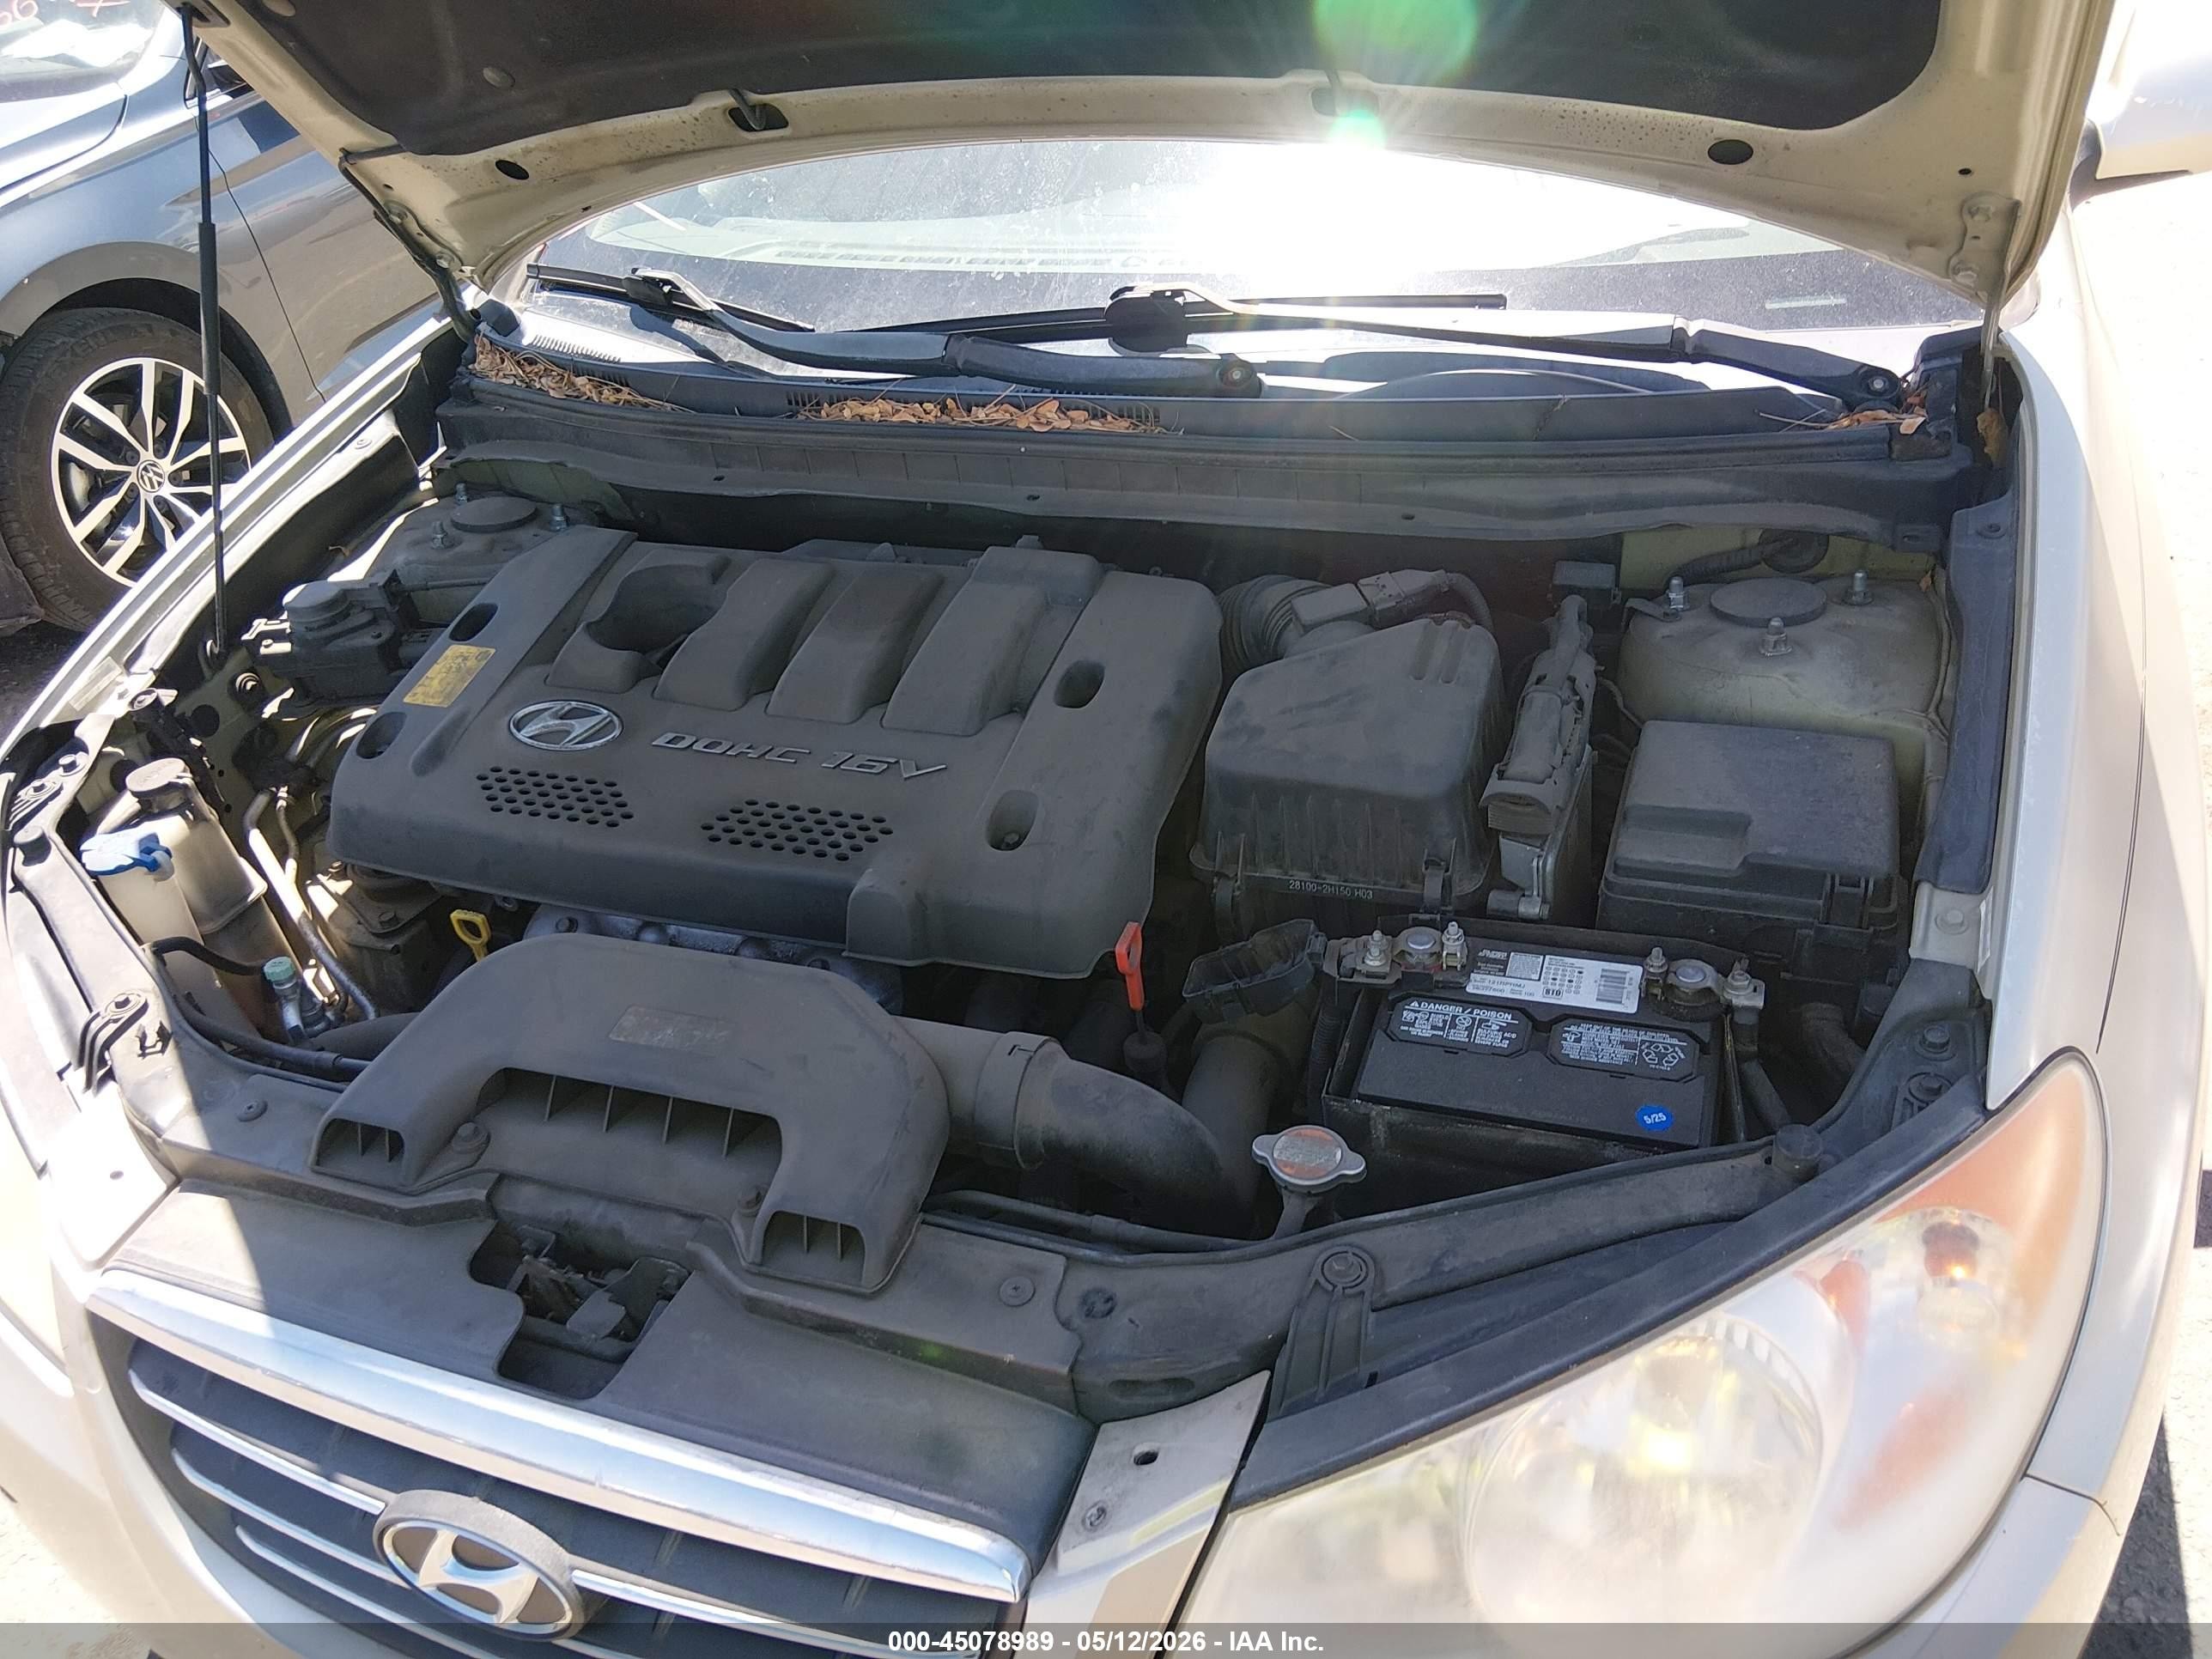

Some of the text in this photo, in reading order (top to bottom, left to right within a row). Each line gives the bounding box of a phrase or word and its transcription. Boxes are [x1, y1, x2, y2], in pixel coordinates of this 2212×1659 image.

[652, 732, 948, 781] DOHC 16V
[1420, 1001, 1463, 1014] DANGER
[1473, 1008, 1512, 1020] POISON
[1643, 1112, 1667, 1125] 5/25
